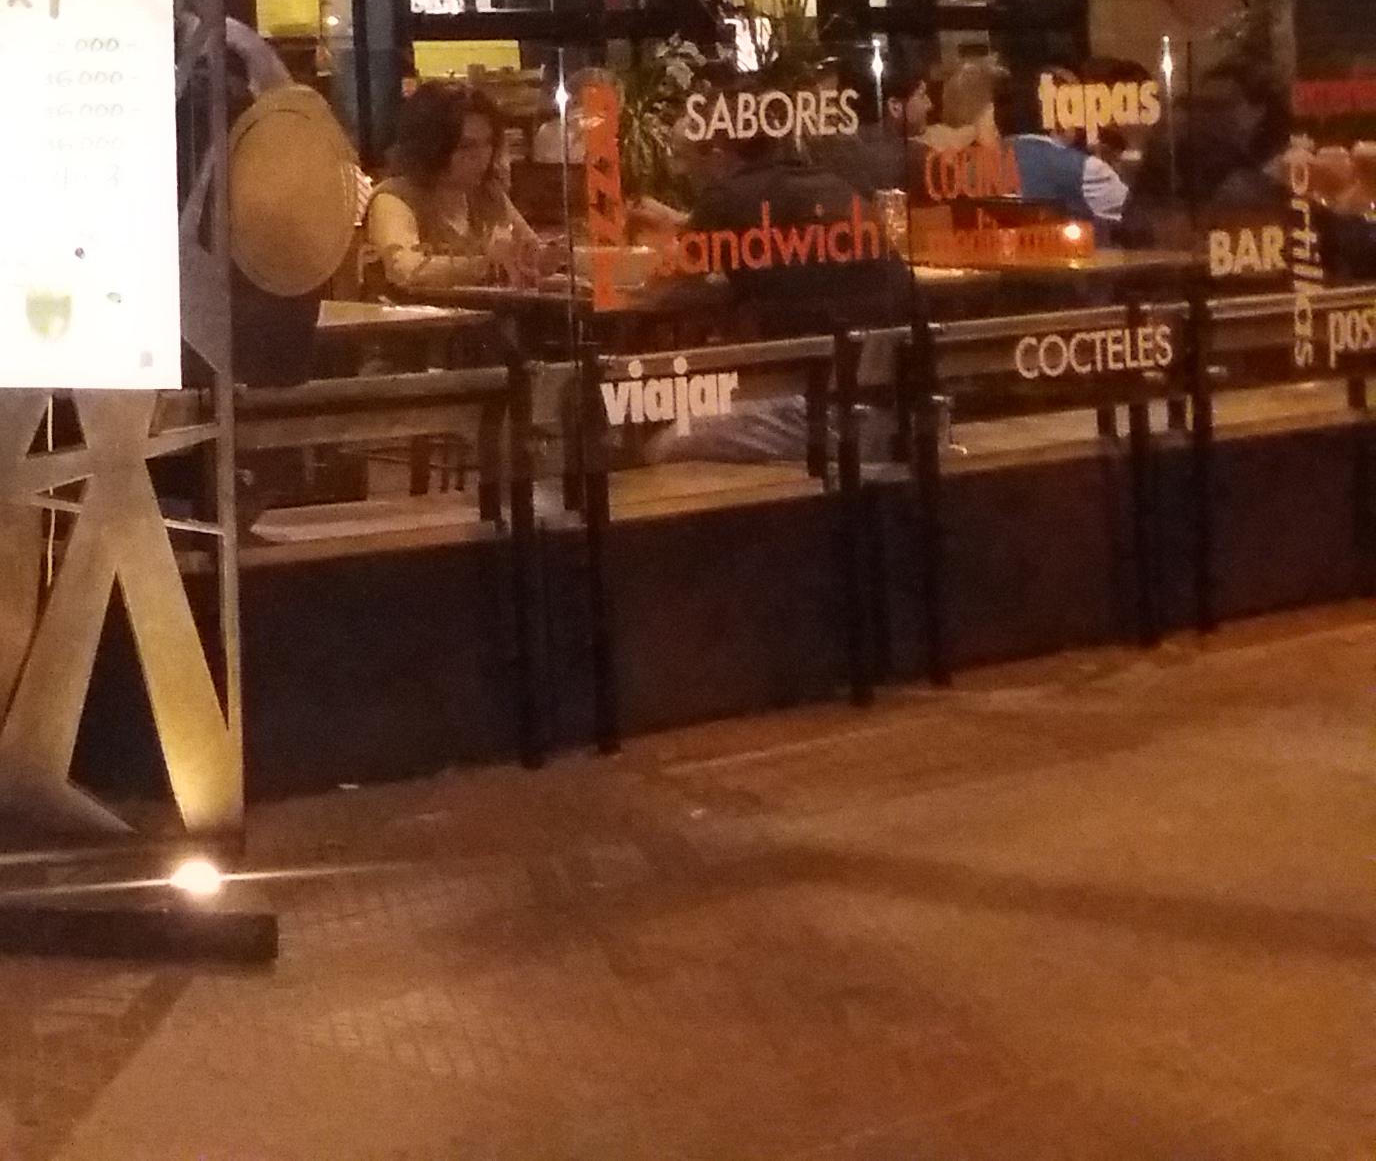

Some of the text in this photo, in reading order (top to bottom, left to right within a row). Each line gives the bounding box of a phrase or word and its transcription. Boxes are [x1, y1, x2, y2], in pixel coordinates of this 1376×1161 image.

[685, 87, 859, 142] SABORES
[1038, 72, 1162, 145] tapas
[1209, 225, 1288, 277] BAR
[1015, 323, 1174, 380] COCTELES
[599, 355, 739, 438] viajar
